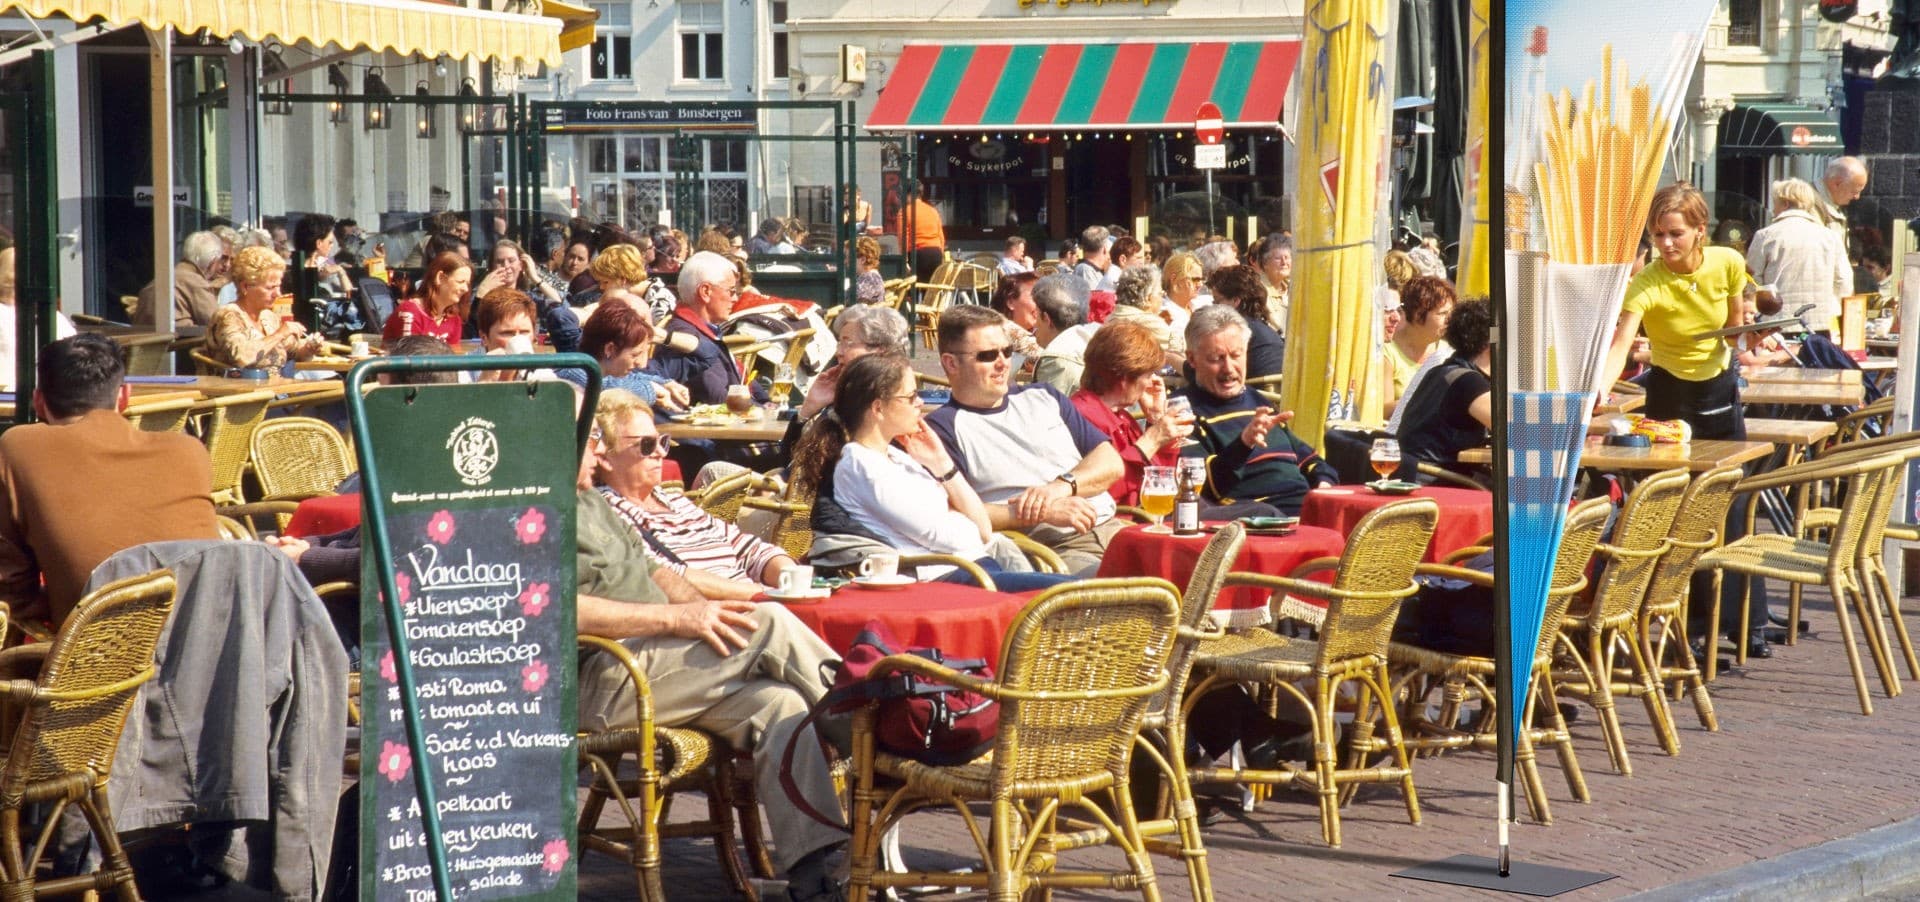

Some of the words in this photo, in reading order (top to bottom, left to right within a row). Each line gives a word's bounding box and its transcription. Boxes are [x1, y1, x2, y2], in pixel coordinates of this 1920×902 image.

[586, 108, 612, 120] Foto
[614, 108, 647, 120] Frans
[648, 110, 669, 120] van
[678, 108, 742, 121] Binsbergen
[949, 155, 961, 167] de
[966, 156, 1024, 173] Suykerpot
[403, 616, 526, 645] Tomatensoep
[430, 700, 495, 720] tomaat
[496, 702, 519, 716] en
[425, 732, 472, 756] Saté
[443, 752, 496, 774] haas
[407, 792, 511, 821] Apeltaart
[389, 828, 415, 850] uit
[470, 822, 538, 845] keuken
[469, 871, 523, 891] salade
